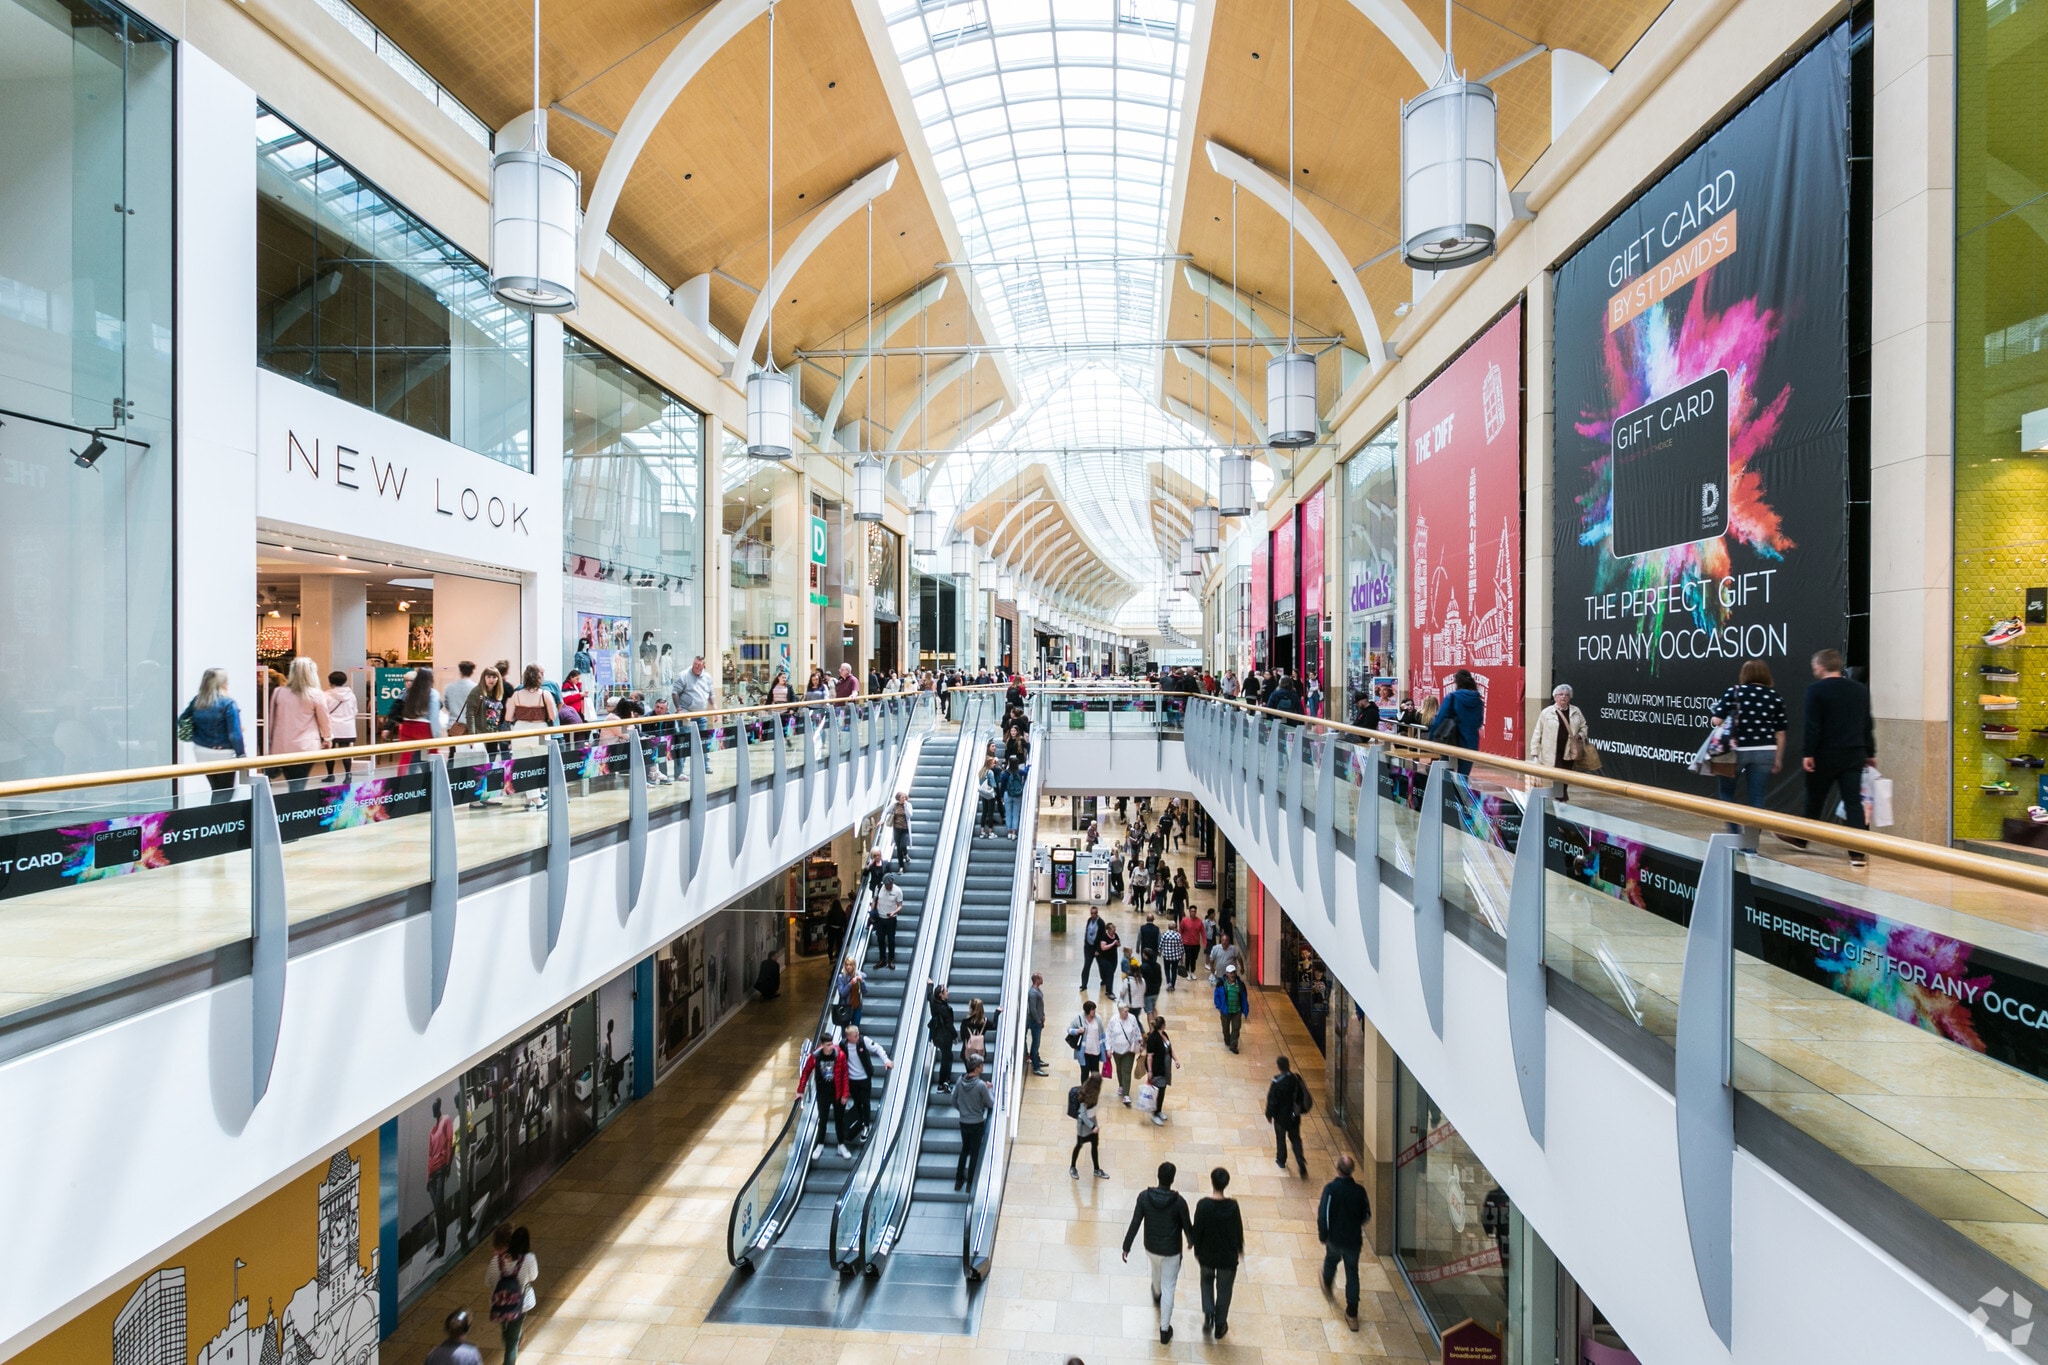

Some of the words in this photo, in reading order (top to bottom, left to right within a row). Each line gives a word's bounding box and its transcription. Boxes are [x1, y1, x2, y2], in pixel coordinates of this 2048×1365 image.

[1608, 227, 1655, 288] GIFT
[1662, 169, 1735, 248] CARD
[1614, 292, 1633, 323] BY
[1636, 275, 1656, 307] ST
[1660, 226, 1728, 292] DAVID'S
[1617, 415, 1654, 449] GIFT
[1660, 389, 1714, 431] CARD
[1415, 431, 1431, 465] THE
[286, 429, 408, 501] NEW
[436, 478, 529, 536] LOOK
[1702, 482, 1720, 517] D
[814, 525, 825, 557] D
[1352, 564, 1389, 612] claire's
[1584, 593, 1616, 621] THE
[1622, 579, 1712, 618] PERFECT
[1718, 569, 1777, 608] GIFT
[777, 624, 786, 635] D
[1578, 634, 1612, 661] FOR
[1616, 632, 1653, 660] ANY
[1659, 622, 1787, 660] OCCASION
[1608, 692, 1621, 704] BUY
[1623, 694, 1641, 705] NOW
[1642, 694, 1664, 707] FROM
[1666, 695, 1682, 708] THE
[1600, 708, 1629, 721] SERVICE
[1629, 709, 1648, 722] DESK
[1649, 711, 1662, 724] ON
[1662, 713, 1687, 727] LEVEL
[1689, 714, 1693, 727] 1
[1695, 715, 1709, 728] OR
[459, 779, 476, 790] CARD
[512, 772, 520, 781] BY
[520, 770, 527, 779] ST
[527, 767, 547, 778] DAVID'S
[292, 807, 316, 820] FROM
[360, 793, 394, 807] SERVICES
[394, 793, 404, 802] OR
[404, 788, 427, 801] ONLINE
[96, 830, 114, 842] GIFT
[116, 828, 139, 840] CARD
[163, 829, 181, 846] BY
[182, 828, 199, 841] ST
[200, 819, 246, 838] DAVID'S
[1547, 836, 1563, 851] GIFT
[1563, 843, 1584, 857] CARD
[16, 851, 64, 872] CARD
[1640, 869, 1653, 884] BY
[1655, 873, 1668, 890] ST
[1745, 905, 1771, 930] THE
[1773, 915, 1841, 954] PERFECT
[1843, 942, 1884, 971] GIFT
[1886, 956, 1927, 988] FOR
[1930, 972, 1979, 1005] ANY
